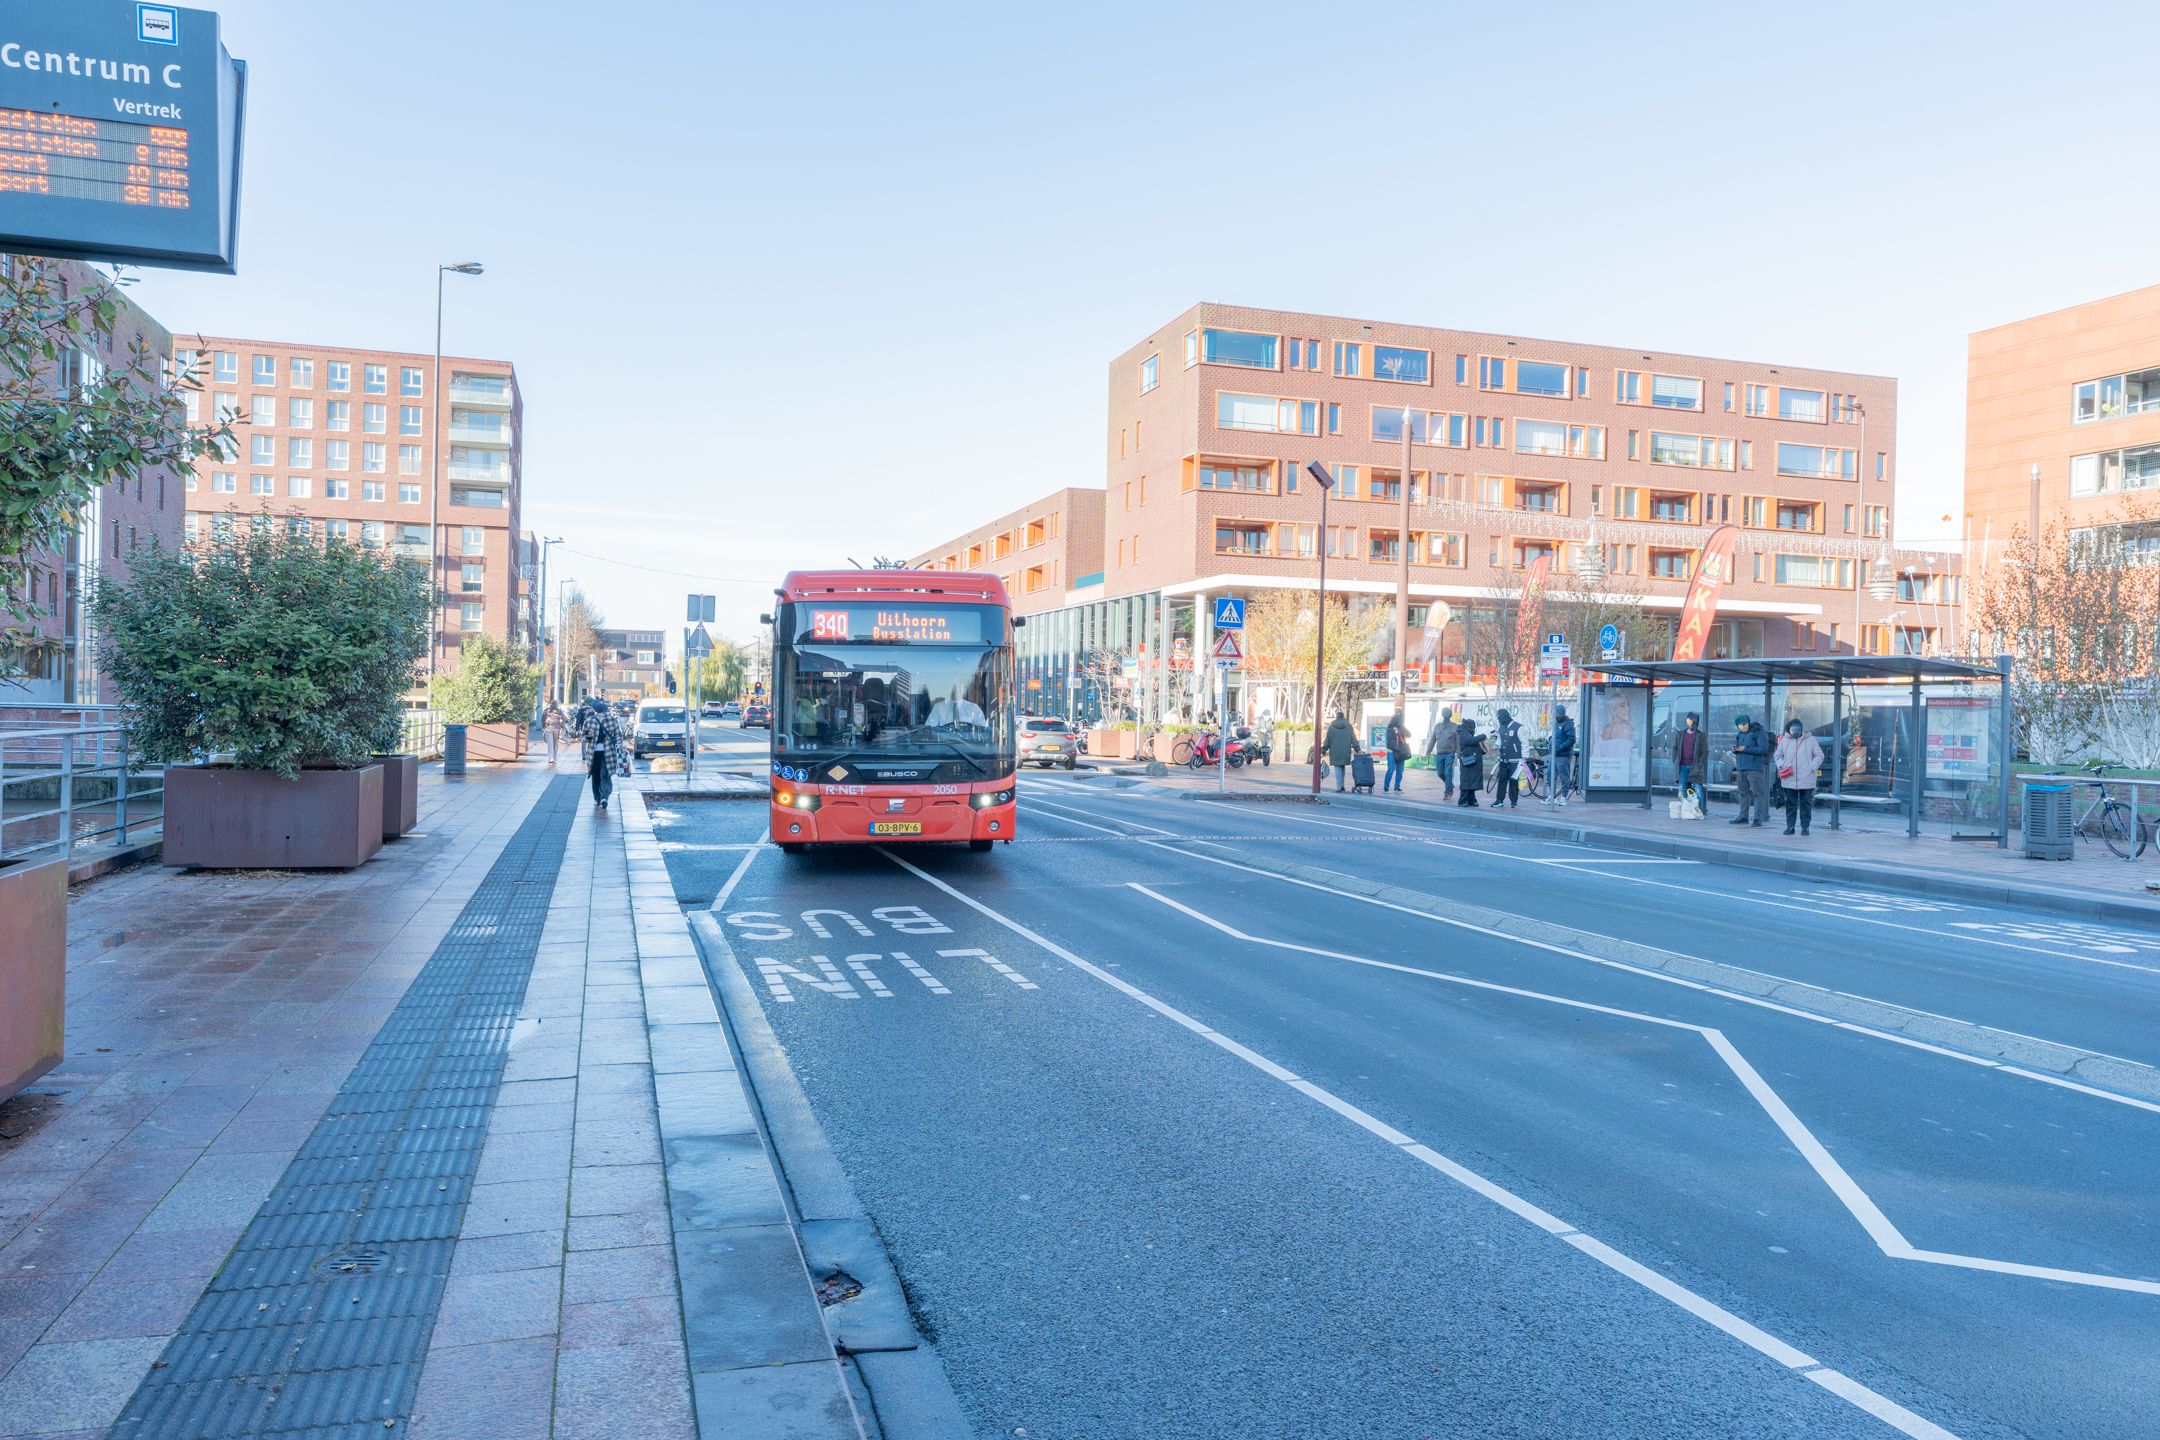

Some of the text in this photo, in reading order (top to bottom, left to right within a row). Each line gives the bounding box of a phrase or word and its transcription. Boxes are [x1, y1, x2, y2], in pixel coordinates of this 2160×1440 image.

[1, 42, 183, 88] Centrum C
[112, 97, 182, 119] Vertrek
[157, 148, 189, 167] min
[127, 165, 152, 183] 10
[157, 169, 189, 188] min
[158, 189, 190, 208] min
[815, 613, 848, 636] 340
[877, 611, 947, 627] Uithoorn
[1678, 587, 1712, 660] KAA
[872, 626, 951, 639] Busstation
[1552, 635, 1560, 643] B
[934, 785, 957, 795] 2050
[726, 905, 955, 941] BUS
[754, 948, 1041, 1003] LIJN
